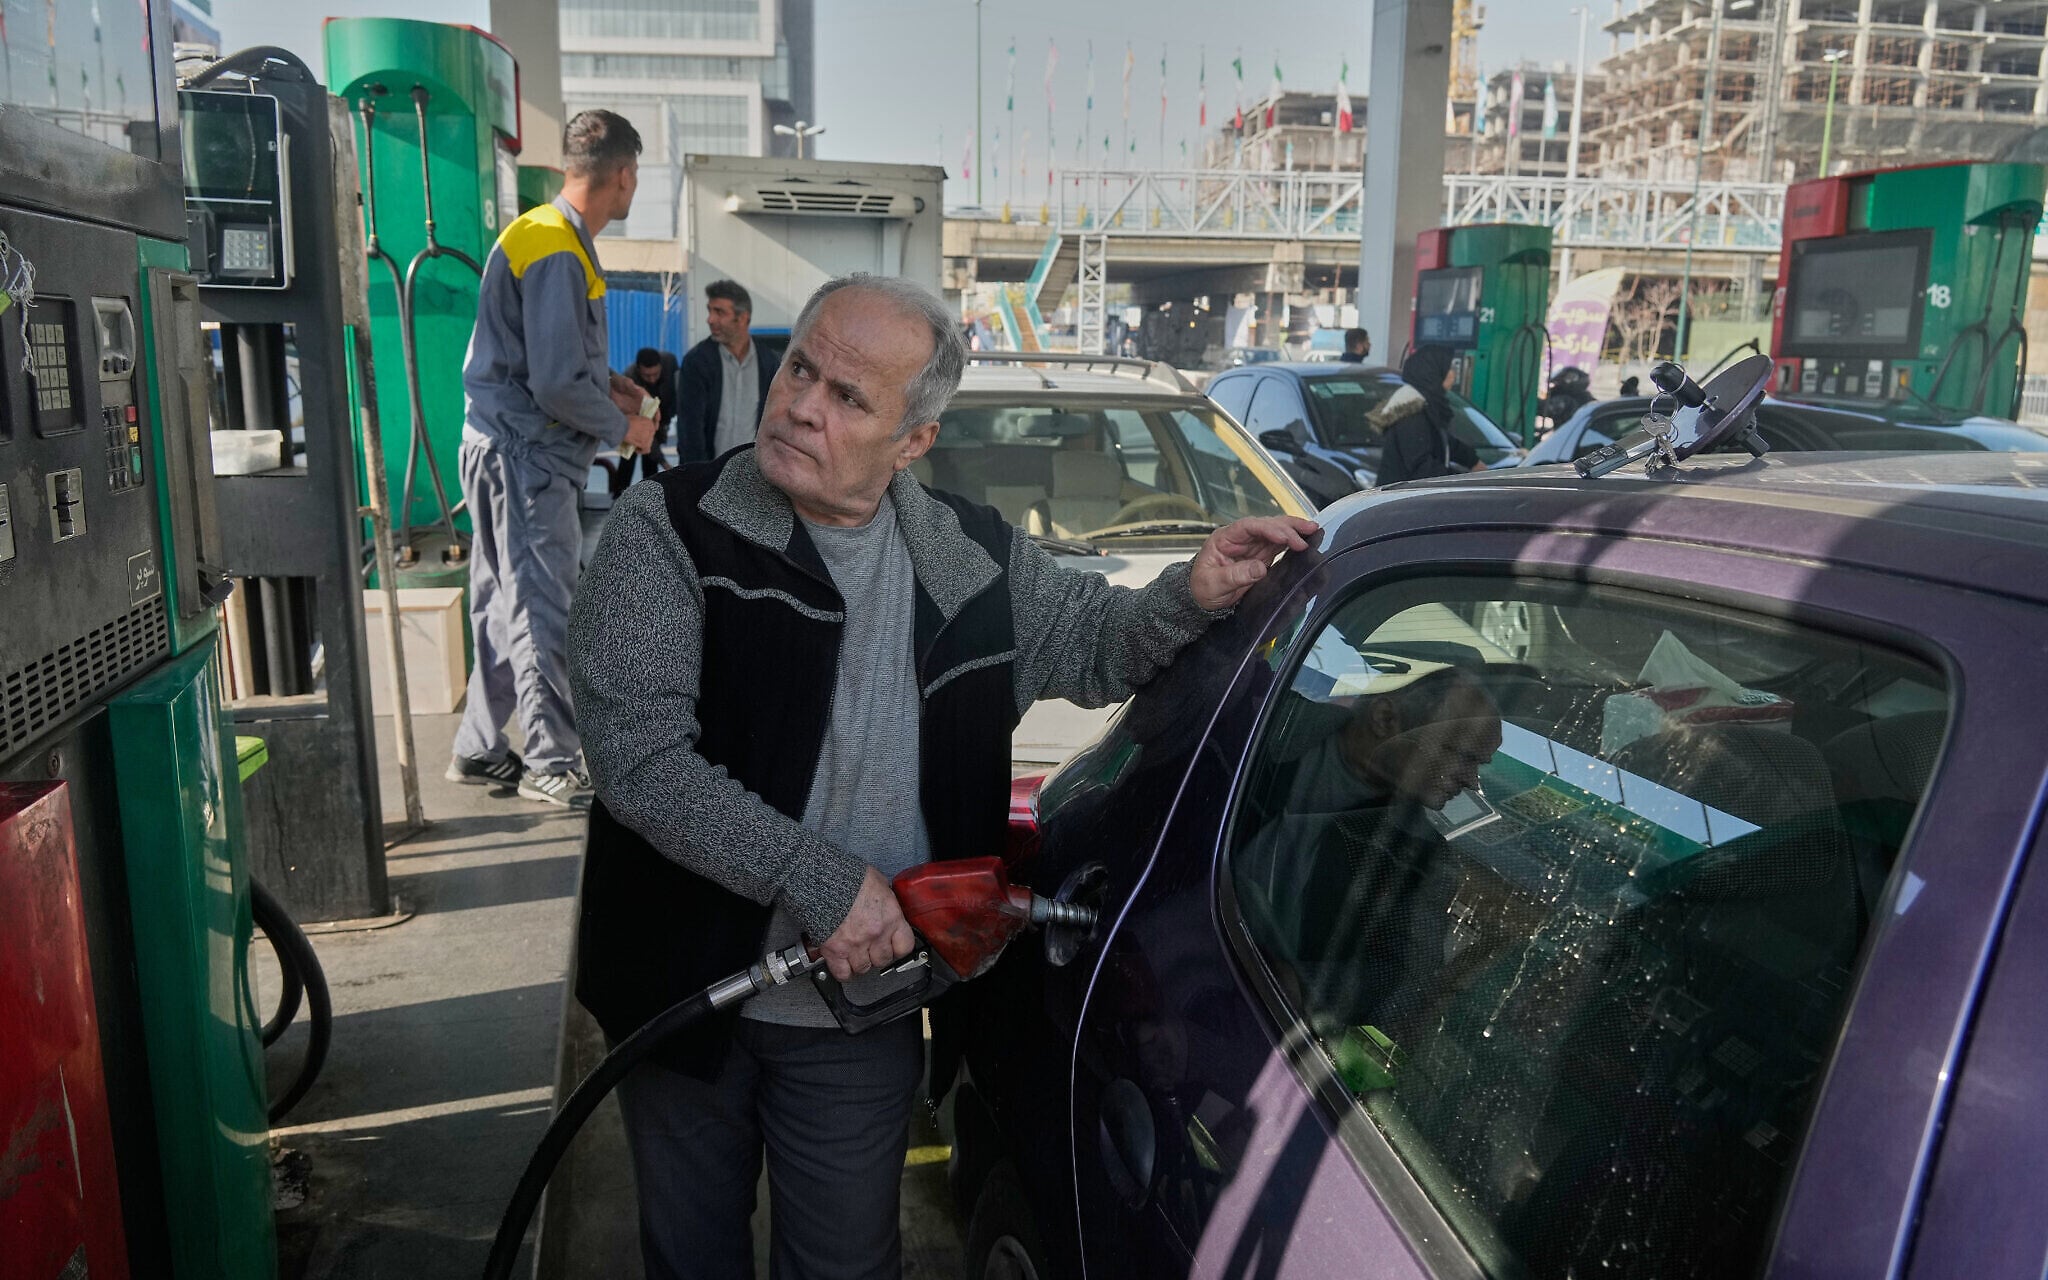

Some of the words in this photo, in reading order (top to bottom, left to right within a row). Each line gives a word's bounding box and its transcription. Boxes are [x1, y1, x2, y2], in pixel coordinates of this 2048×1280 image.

[485, 199, 495, 230] 8
[1926, 282, 1952, 309] 18
[1479, 306, 1496, 324] 21
